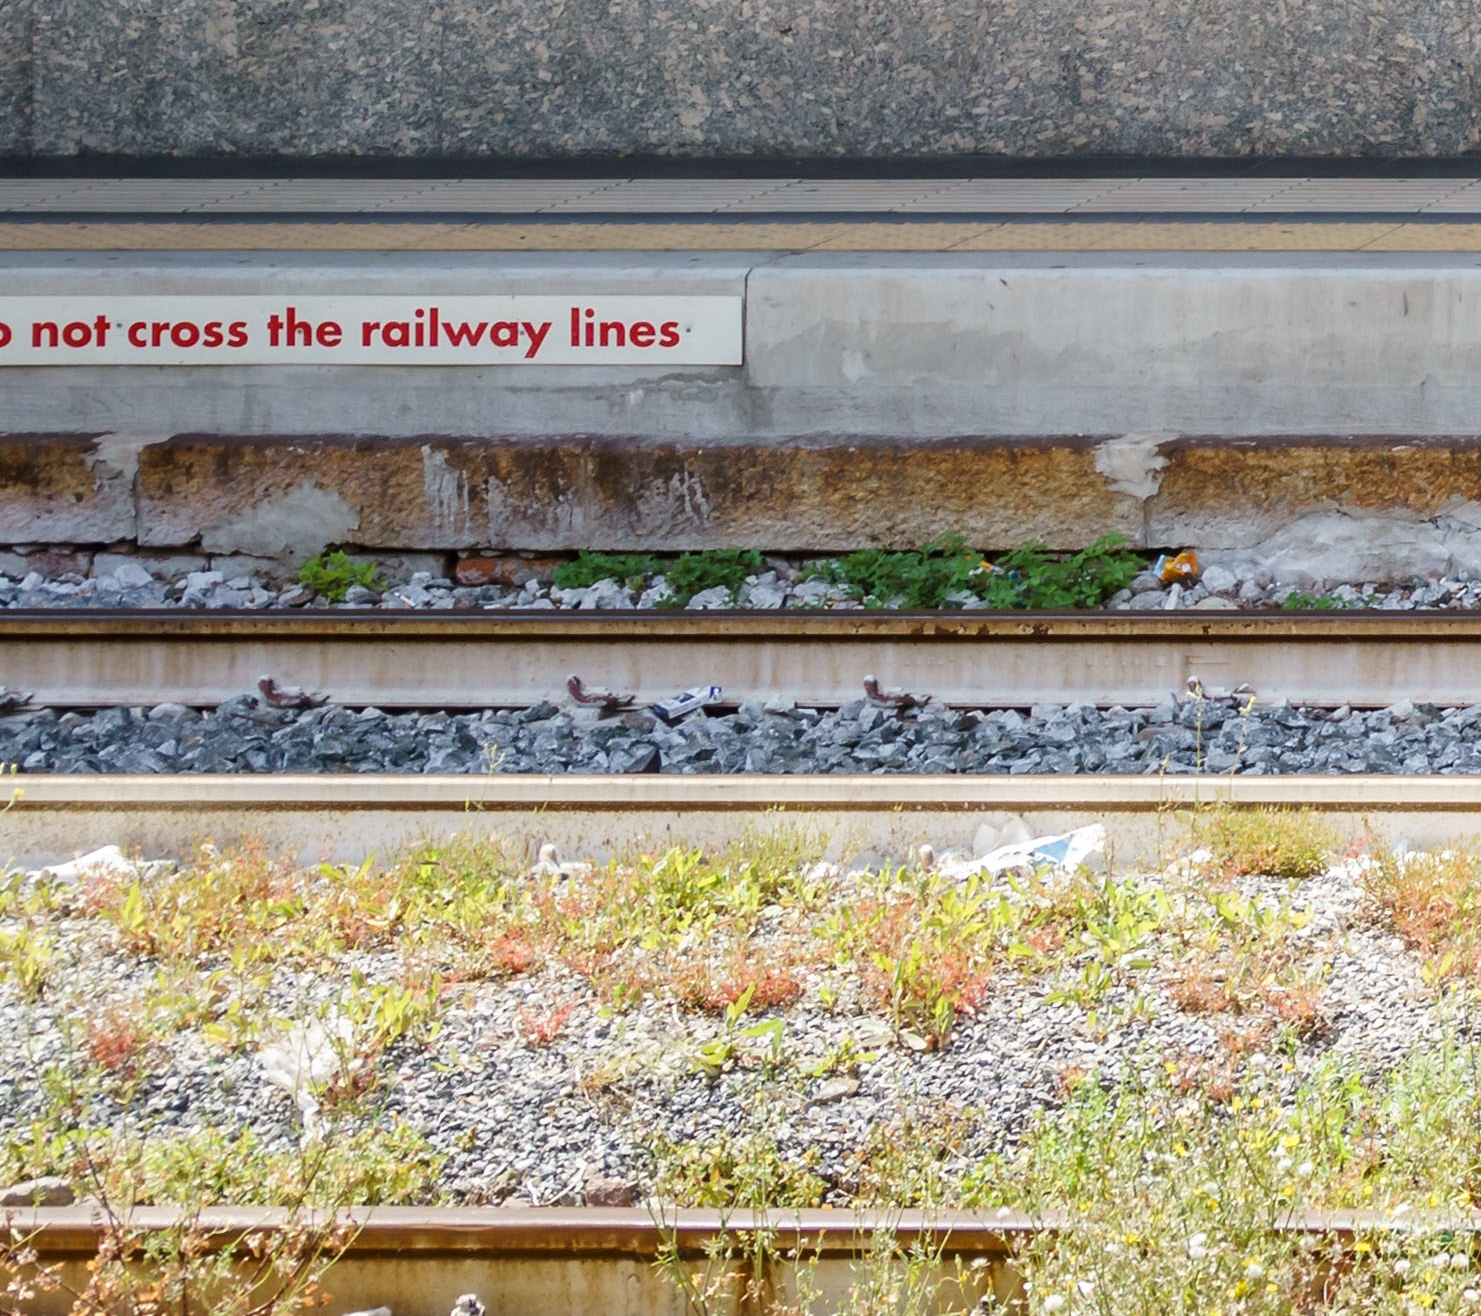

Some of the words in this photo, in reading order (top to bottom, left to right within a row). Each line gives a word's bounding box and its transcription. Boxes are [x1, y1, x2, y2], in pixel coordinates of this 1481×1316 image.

[31, 315, 111, 348] not
[127, 321, 249, 348] cross
[267, 307, 343, 348] the
[361, 307, 553, 358] railway
[571, 307, 681, 348] lines
